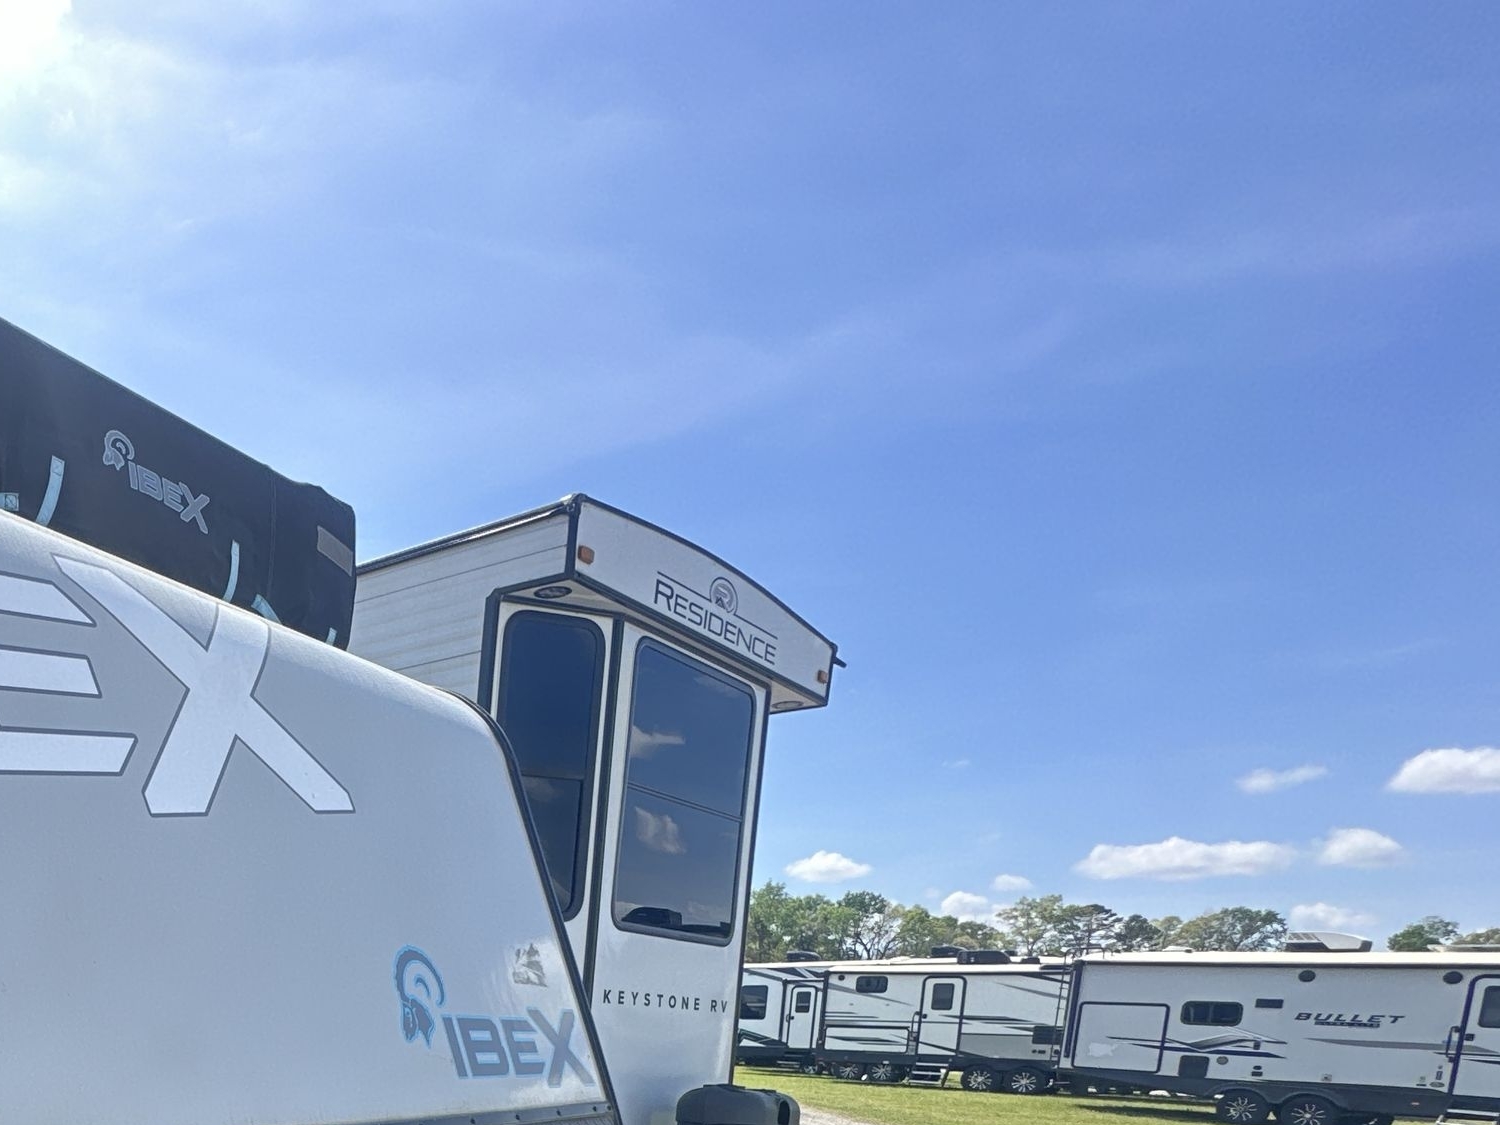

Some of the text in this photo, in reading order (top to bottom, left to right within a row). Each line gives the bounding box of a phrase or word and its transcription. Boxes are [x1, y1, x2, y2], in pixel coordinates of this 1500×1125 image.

[127, 460, 210, 534] IBEX
[653, 578, 777, 666] RESIDENCE
[602, 989, 728, 1013] KEYSTONE RV
[1294, 1012, 1406, 1024] BULLET
[440, 1005, 596, 1088] IBEX
